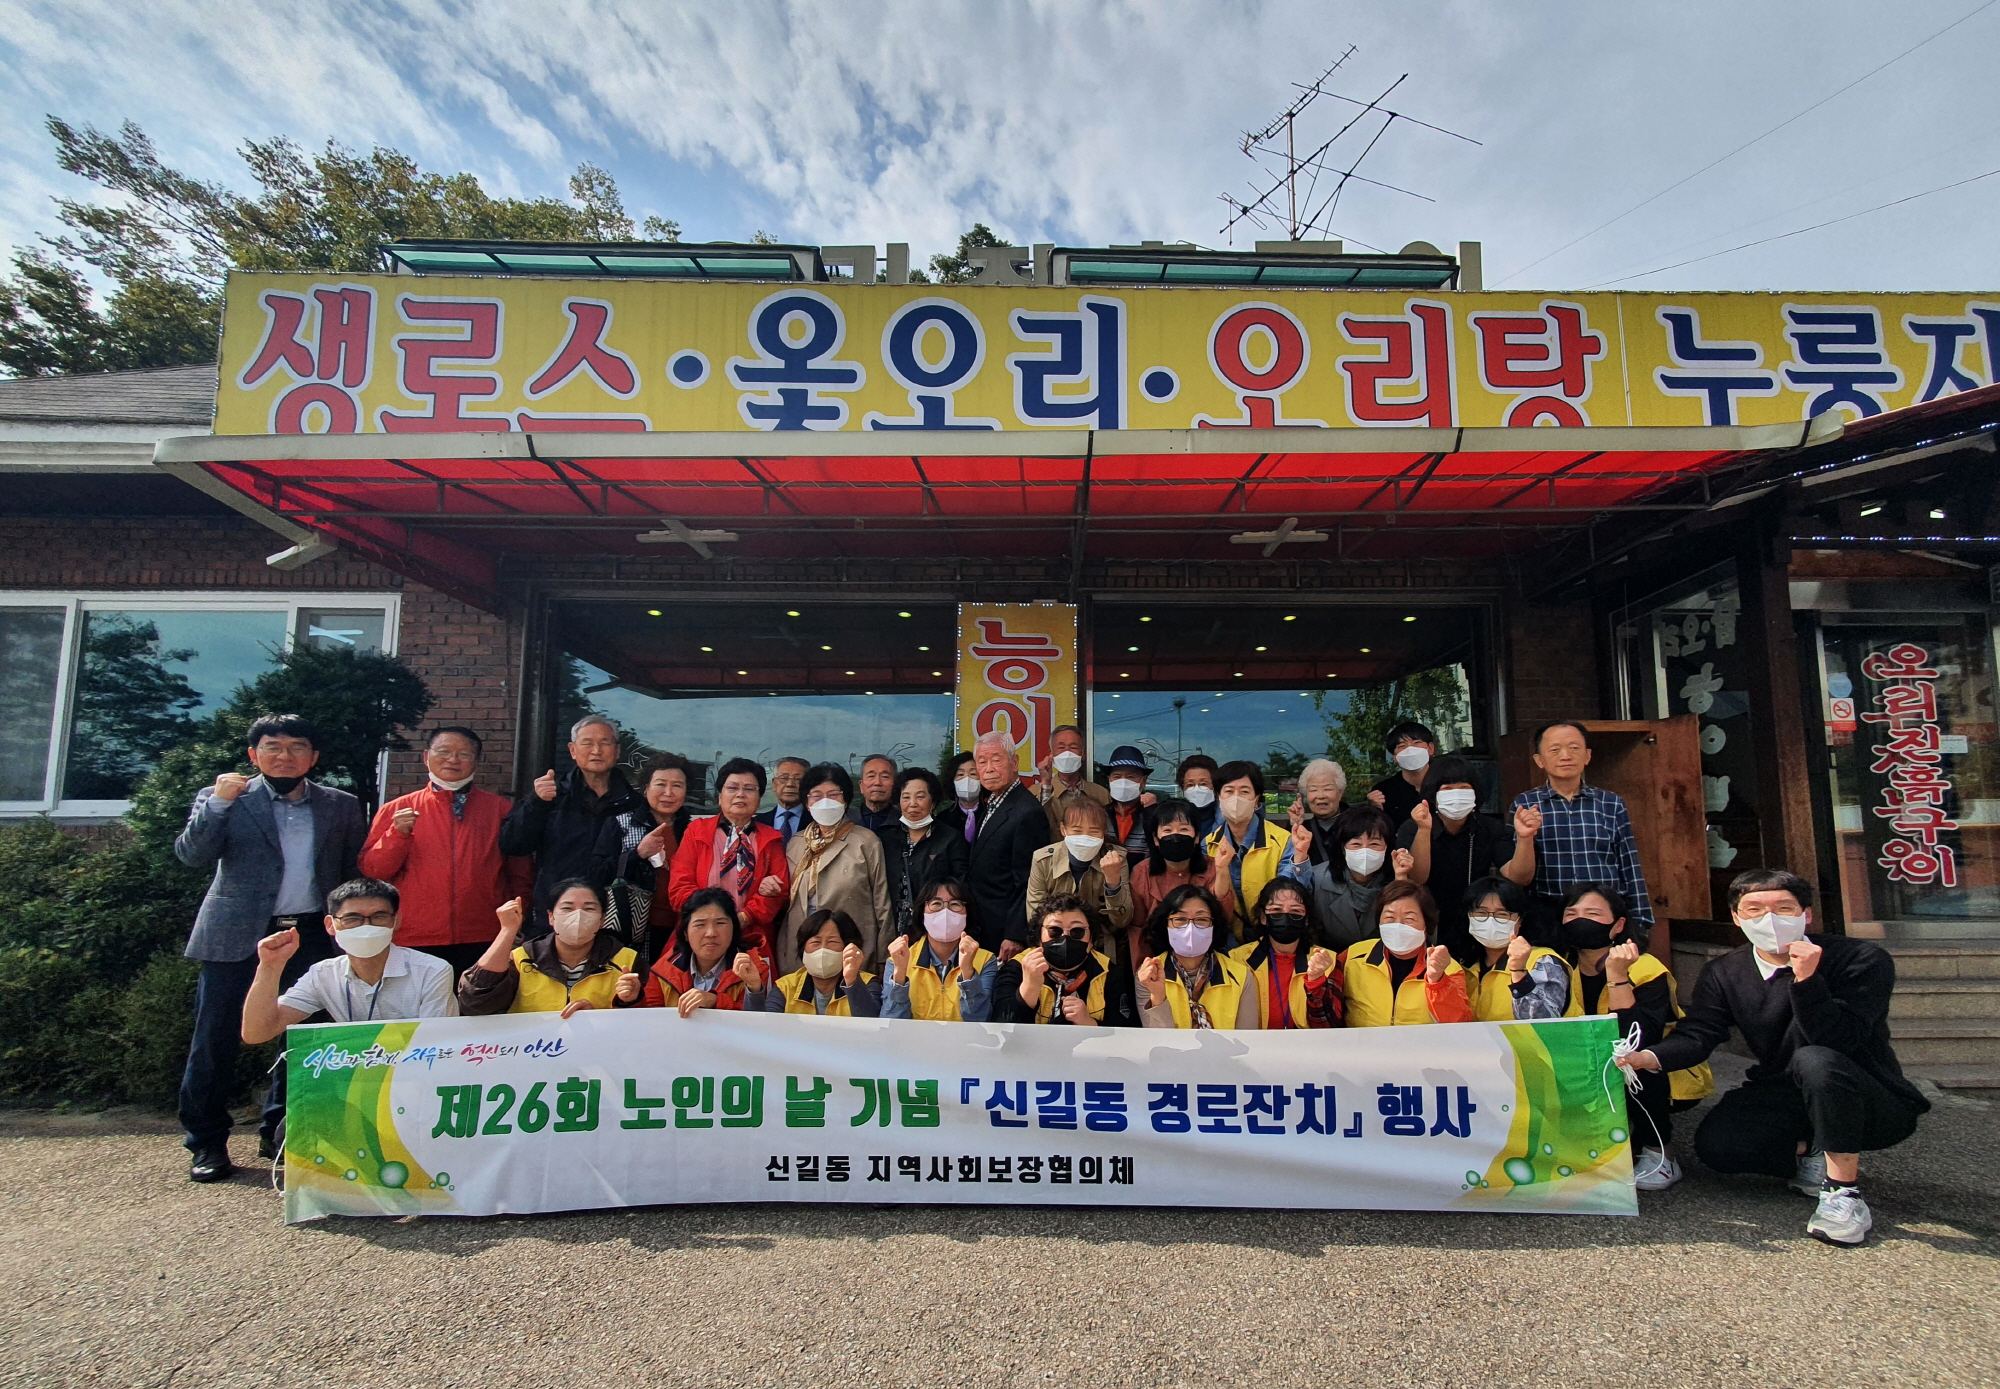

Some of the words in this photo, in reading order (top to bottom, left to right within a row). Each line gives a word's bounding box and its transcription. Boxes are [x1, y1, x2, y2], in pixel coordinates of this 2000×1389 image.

[240, 285, 651, 433] 생로스
[1196, 303, 1602, 430] 오리탕
[969, 618, 1062, 788] 능이
[1872, 643, 1958, 887] 오리진흙구이
[402, 1046, 455, 1070] 자유로운
[460, 1043, 519, 1066] 혁신도시
[523, 1037, 569, 1058] 안산
[431, 1076, 602, 1139] 제26회
[619, 1075, 764, 1131] 노인의
[784, 1076, 833, 1129] 날
[848, 1077, 941, 1128] 기념
[1376, 1083, 1477, 1139] 행사
[765, 1154, 851, 1183] 신길동
[866, 1154, 1135, 1185] 지역사회보장협의체
